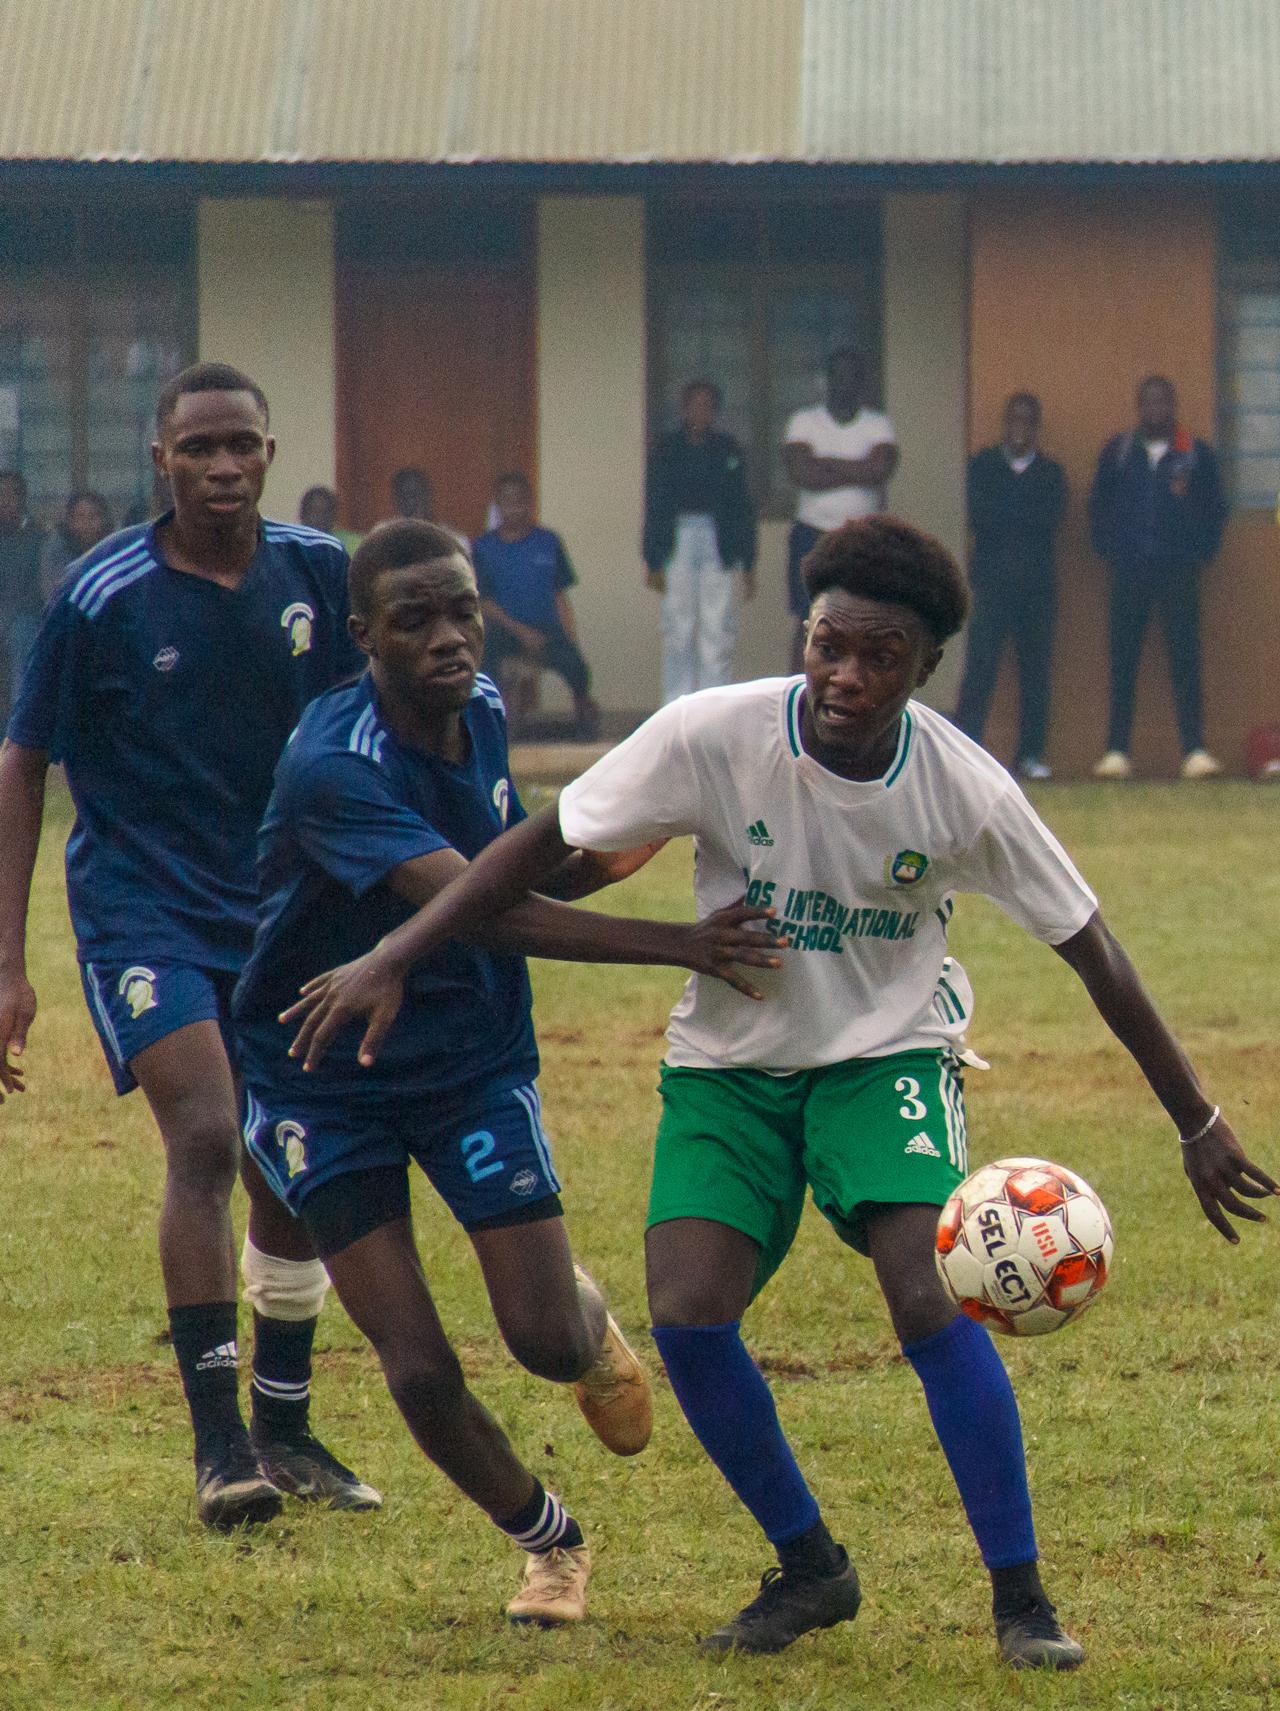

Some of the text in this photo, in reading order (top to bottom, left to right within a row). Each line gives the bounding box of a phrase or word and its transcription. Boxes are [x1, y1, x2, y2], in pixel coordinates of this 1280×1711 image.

[783, 888, 920, 941] INTERNATIONAL
[894, 1076, 928, 1120] 3
[461, 1130, 505, 1183] 2
[904, 1145, 941, 1158] adidas
[196, 1356, 238, 1370] adida
